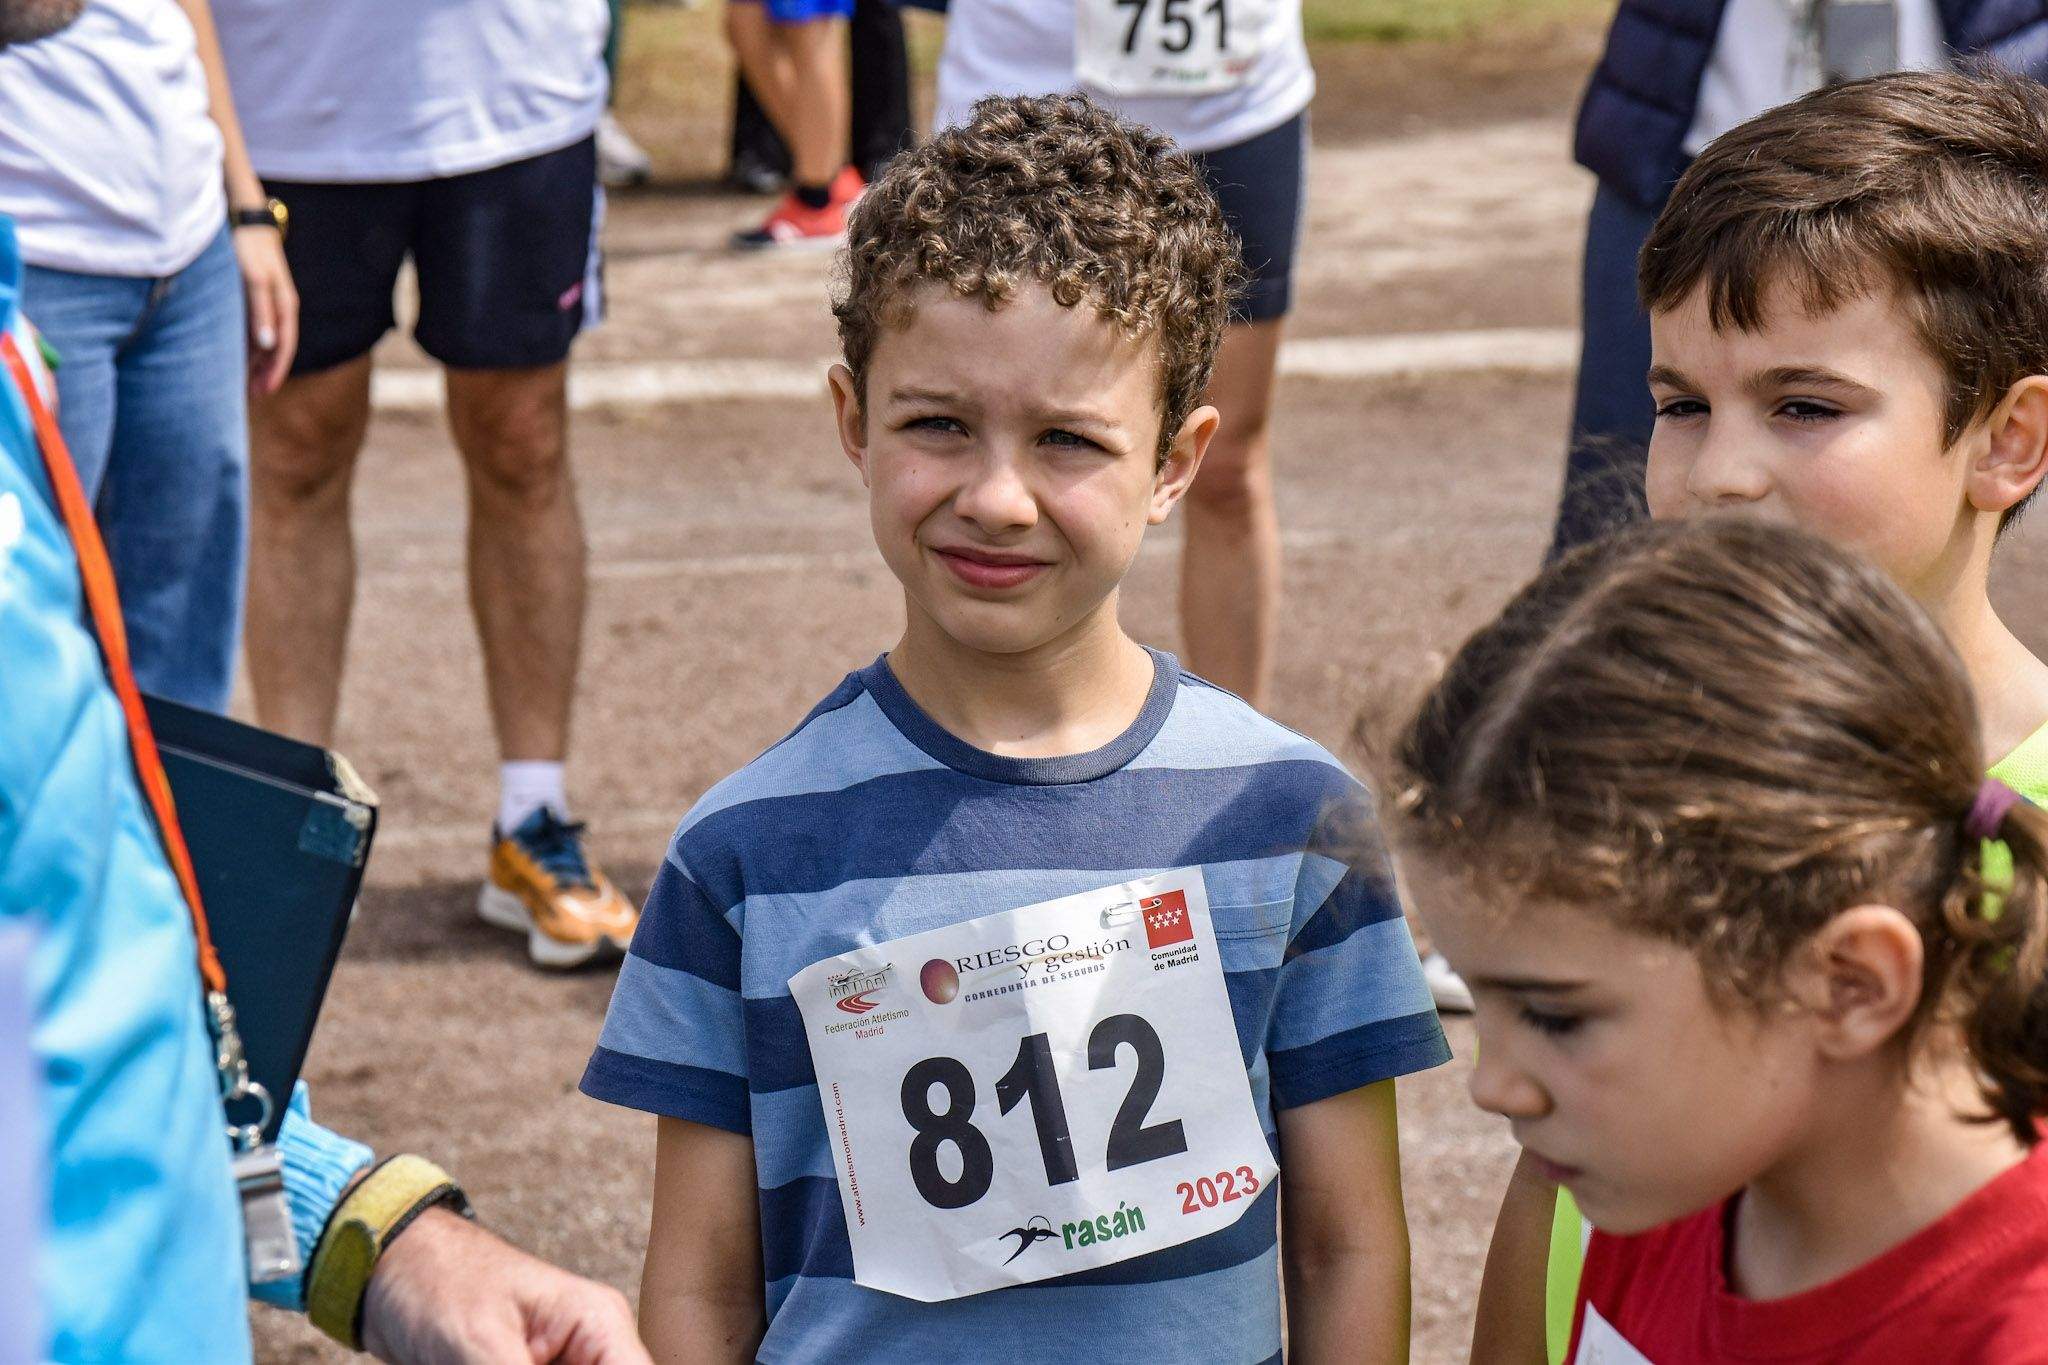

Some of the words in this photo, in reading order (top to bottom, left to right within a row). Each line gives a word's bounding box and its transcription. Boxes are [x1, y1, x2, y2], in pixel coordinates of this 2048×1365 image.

[1115, 0, 1228, 54] 751
[954, 934, 1070, 973] RIESGO
[1016, 962, 1033, 979] y
[1045, 937, 1133, 973] gestión
[1151, 944, 1198, 961] Comunidad
[1154, 961, 1166, 971] de
[1167, 953, 1200, 968] Madrid
[964, 979, 1037, 1002] CORREDURÍA
[1042, 973, 1056, 986] DE
[1060, 963, 1106, 980] SEGUROS
[825, 1016, 871, 1036] Federación
[871, 1008, 910, 1026] Atletismo
[855, 1024, 885, 1040] Madrid
[900, 1013, 1189, 1210] 812
[832, 1082, 866, 1227] www.atletismomadrid.com
[1175, 1165, 1261, 1215] 2023
[1062, 1200, 1146, 1250] rasán
